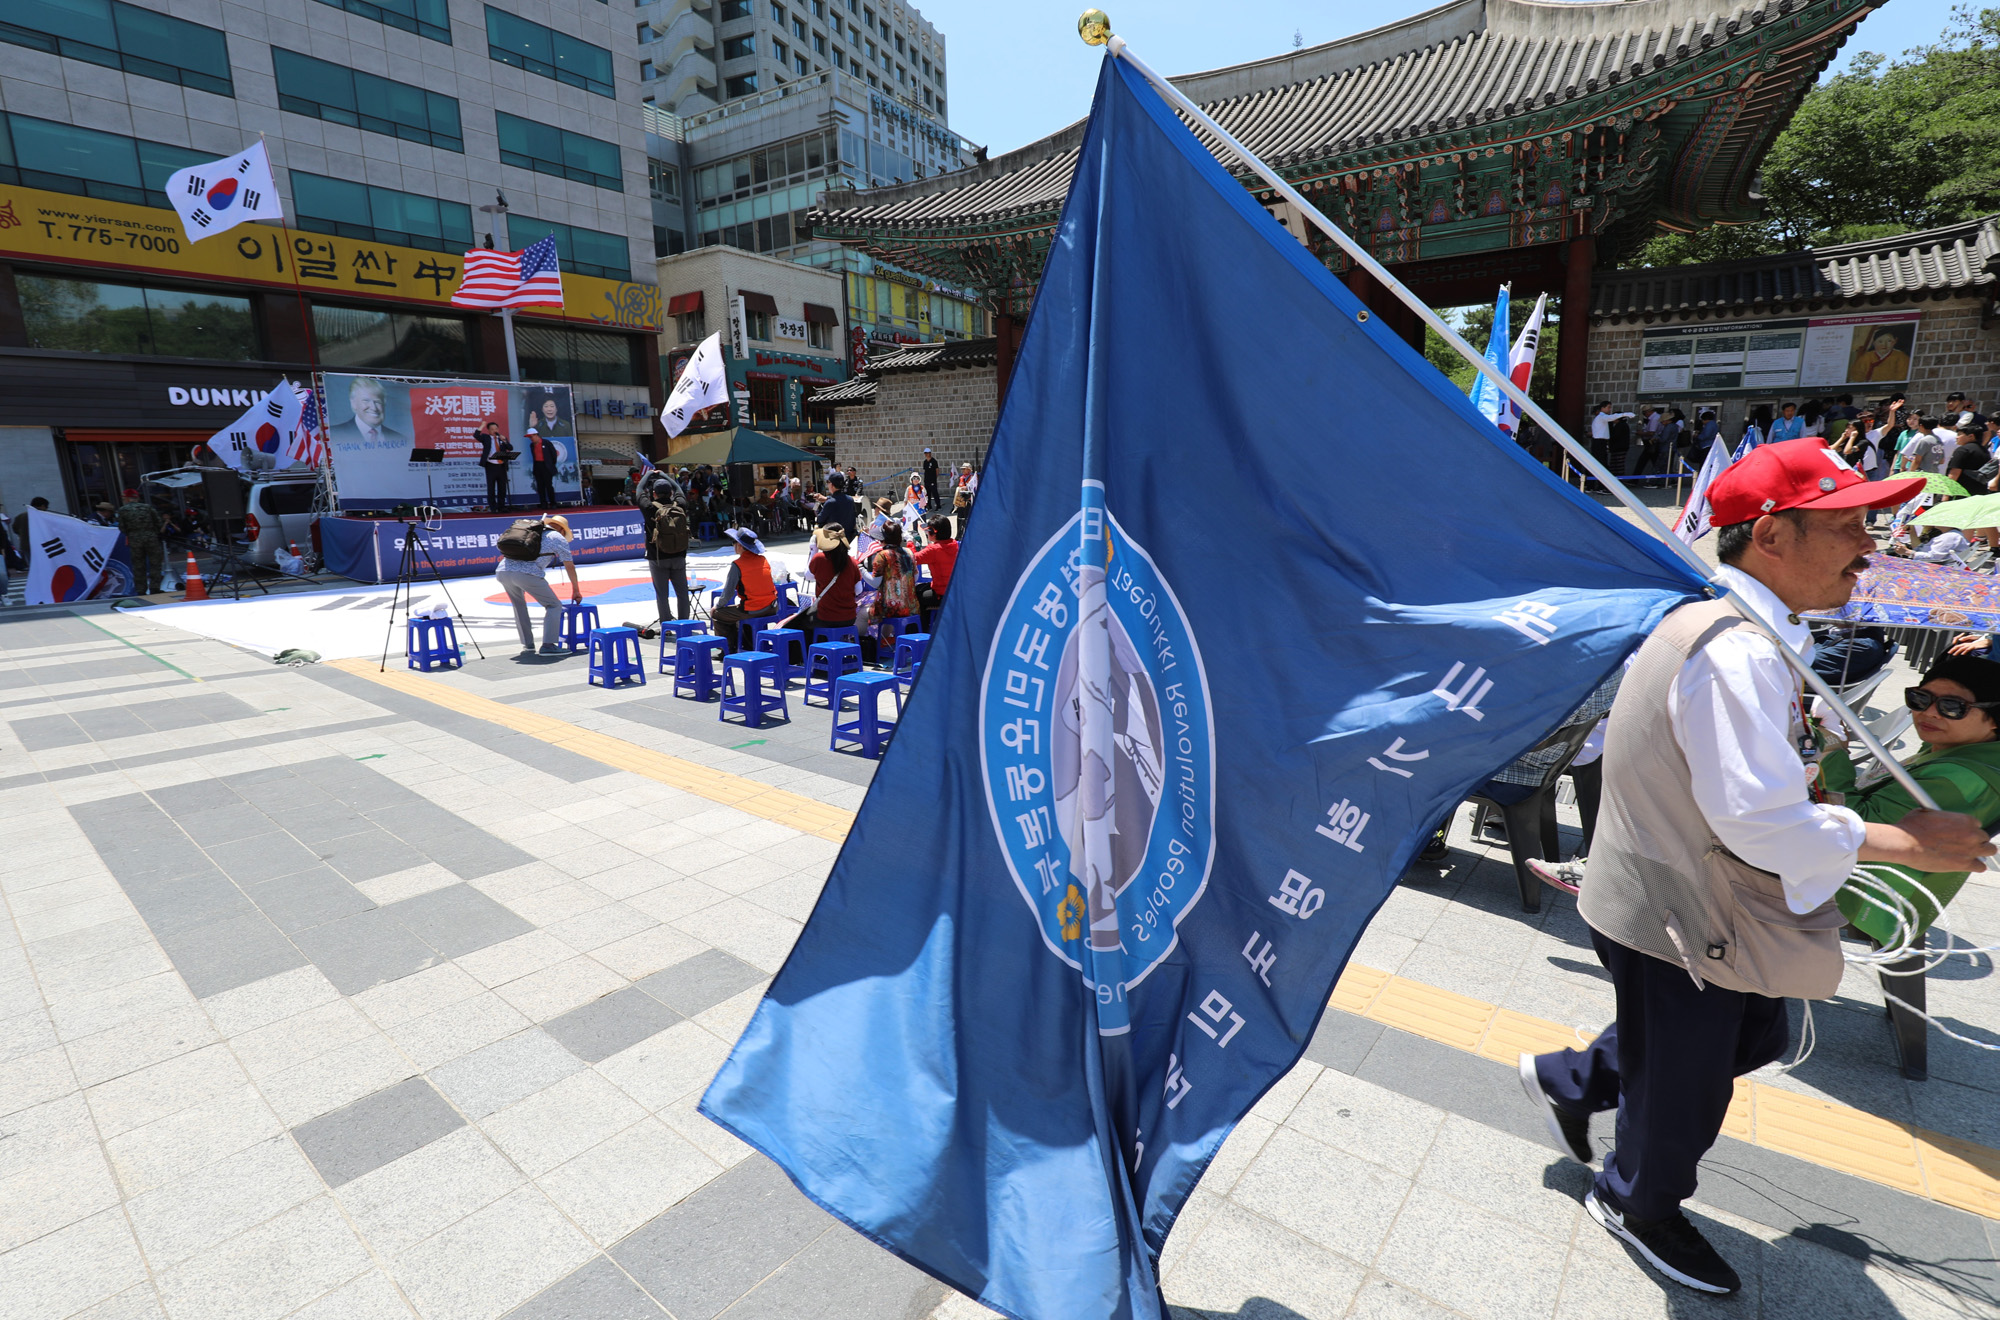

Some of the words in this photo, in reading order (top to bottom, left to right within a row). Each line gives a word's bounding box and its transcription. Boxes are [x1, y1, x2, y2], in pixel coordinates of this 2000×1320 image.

[38, 208, 176, 234] www.yiersan.com
[39, 220, 62, 240] T.
[68, 225, 180, 255] 775-7000
[583, 526, 624, 539] 대한민국을
[436, 558, 457, 567] crisis
[459, 557, 466, 566] of
[604, 543, 625, 553] protect
